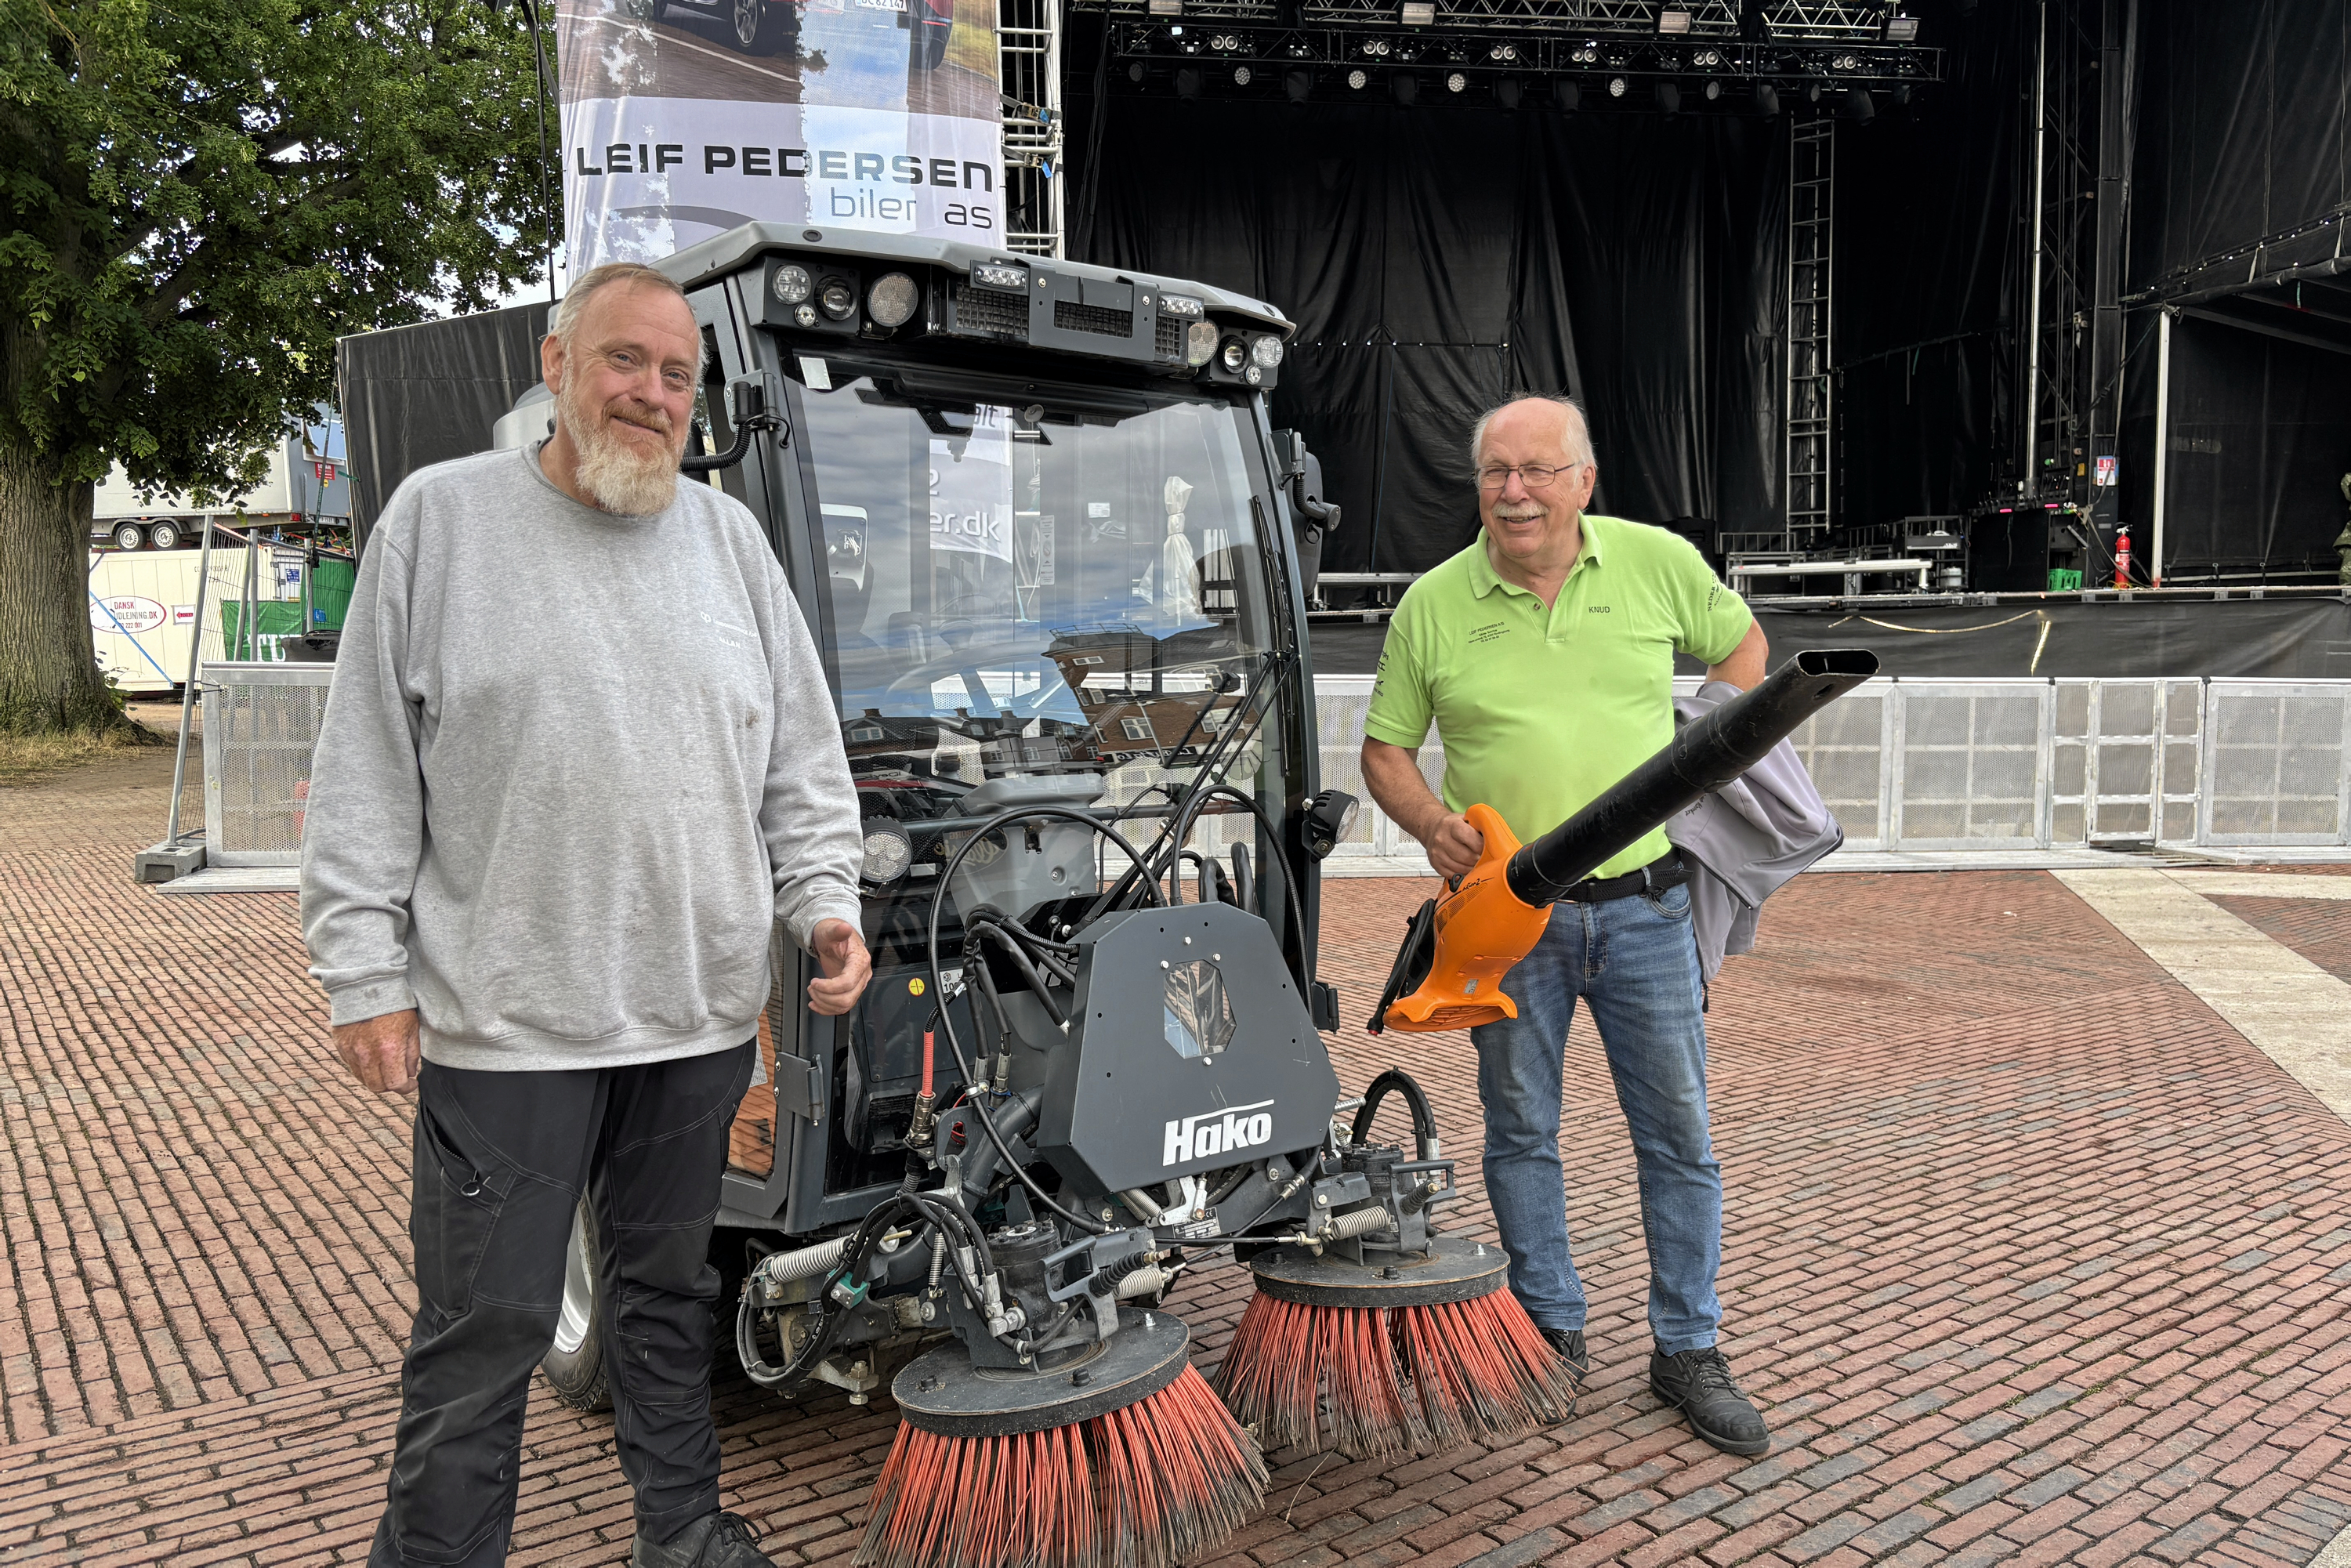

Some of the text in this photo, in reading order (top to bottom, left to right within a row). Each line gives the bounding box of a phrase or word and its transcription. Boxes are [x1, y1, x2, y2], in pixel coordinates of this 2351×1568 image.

[577, 143, 992, 193] LEIF PEDERSEN
[831, 186, 992, 230] biler as
[114, 601, 135, 610] DANSK
[1477, 624, 1498, 632] PEDERSEN
[719, 636, 741, 649] ALLAN
[1162, 1100, 1274, 1167] Hako
